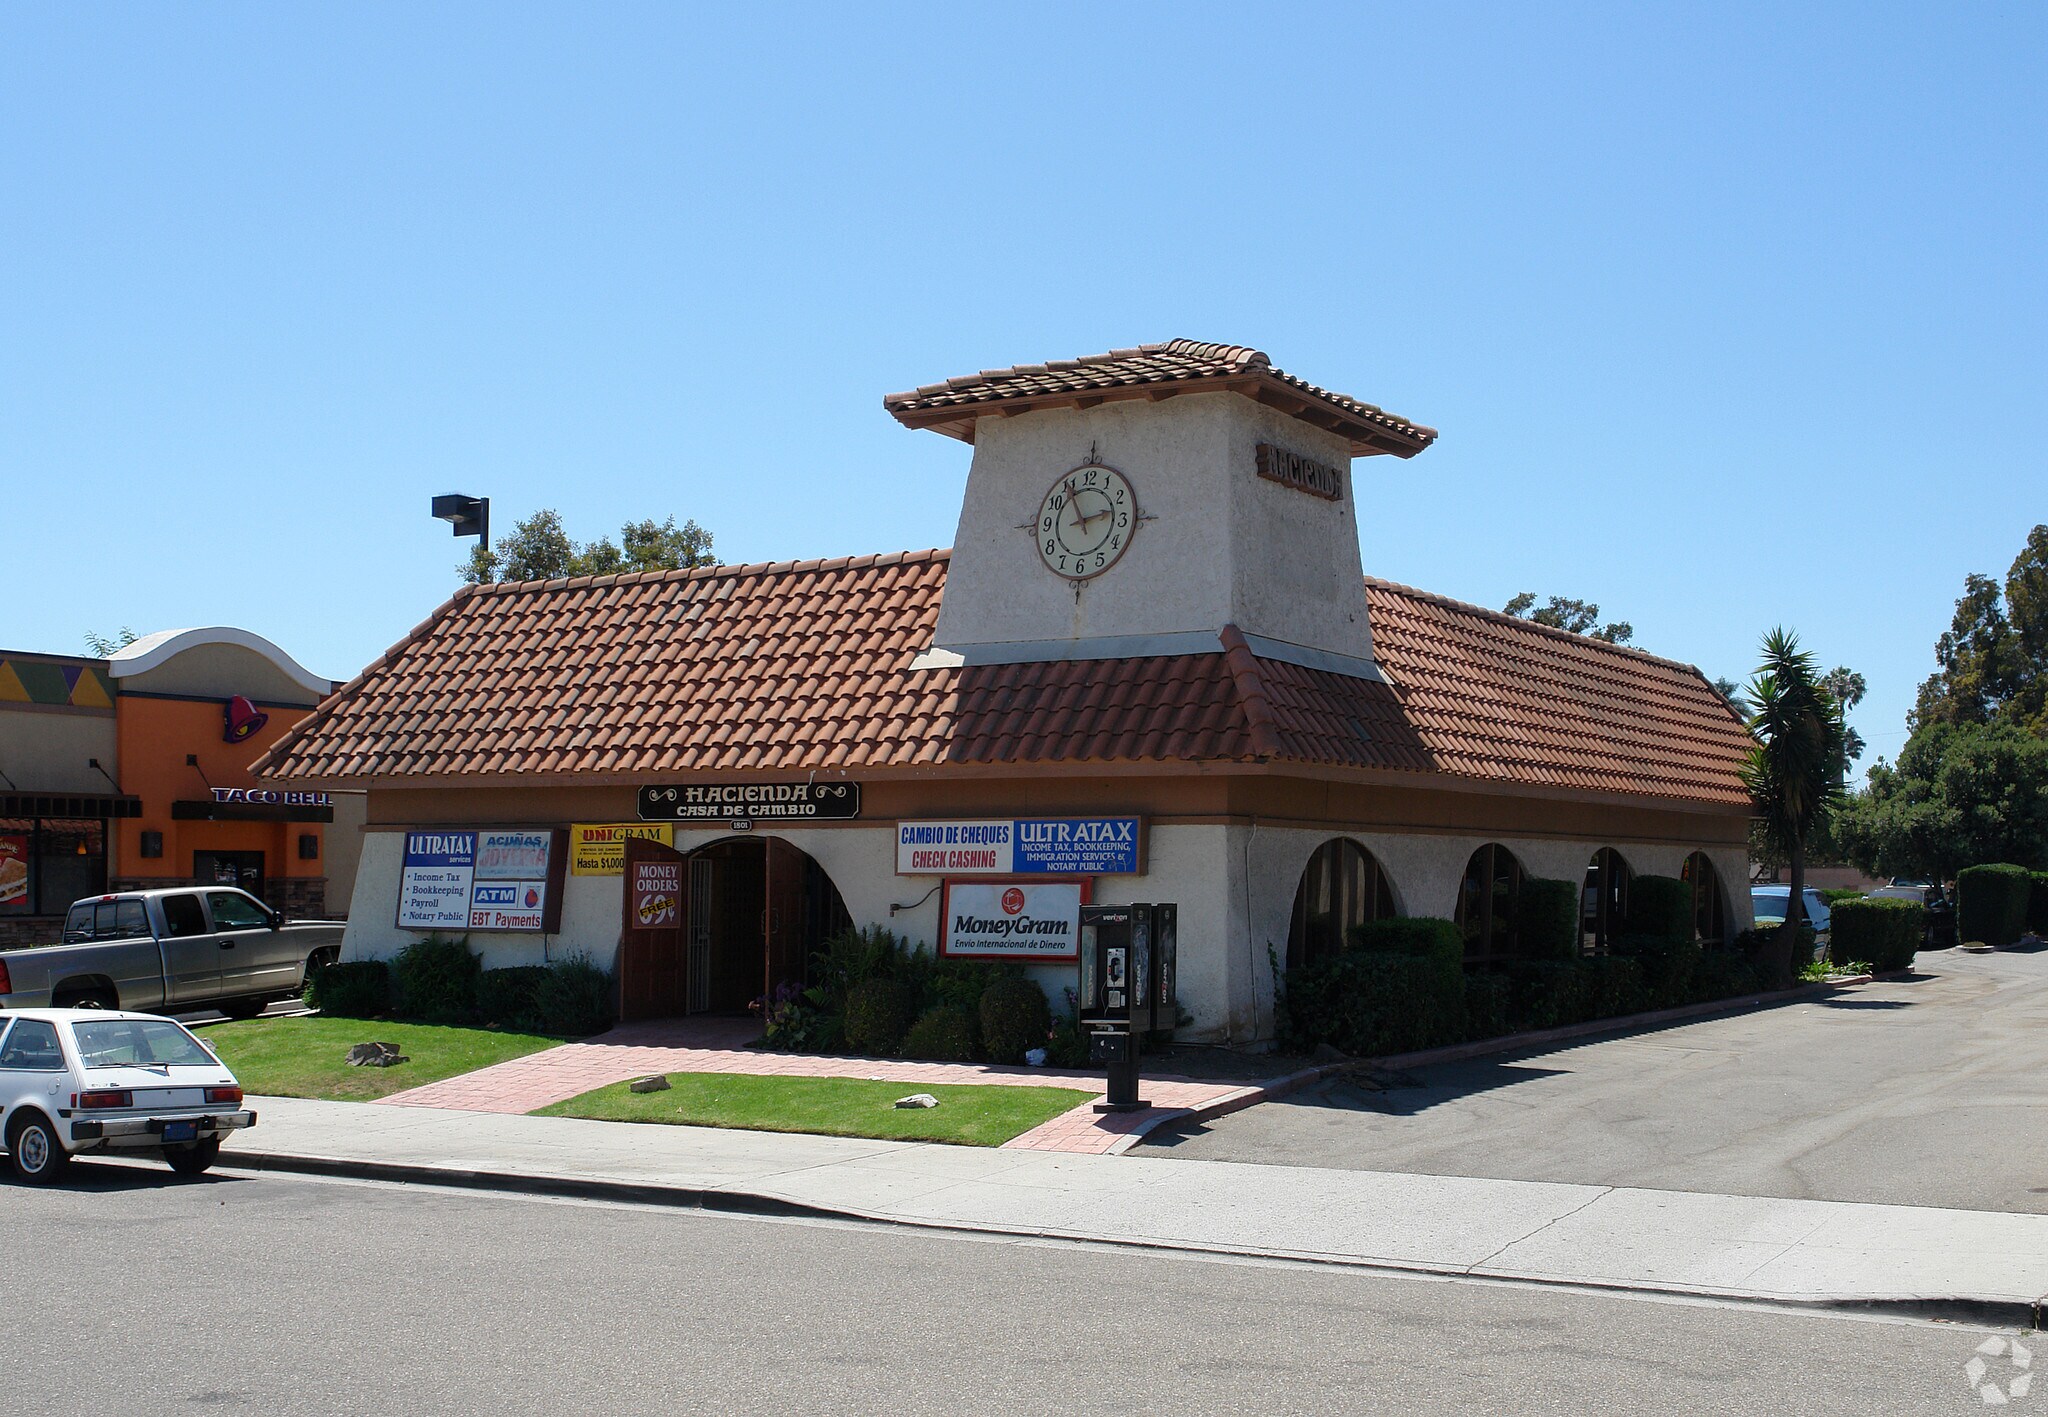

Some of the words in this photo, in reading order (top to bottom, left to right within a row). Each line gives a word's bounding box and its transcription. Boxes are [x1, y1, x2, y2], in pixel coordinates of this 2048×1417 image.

[1062, 477, 1077, 493] 11
[1082, 471, 1097, 486] 12
[1103, 475, 1111, 489] 1
[1048, 495, 1062, 510] 10
[1116, 490, 1124, 504] 2
[1043, 517, 1052, 532] 9
[1117, 512, 1127, 527] 3
[1045, 539, 1055, 555] 8
[1111, 534, 1120, 549] 4
[1059, 555, 1067, 570] 7
[1075, 559, 1084, 573] 6
[1095, 552, 1105, 567] 5
[210, 787, 280, 804] TACO
[284, 792, 334, 806] BELL
[686, 785, 808, 803] HACIENDA
[676, 805, 719, 816] CASA
[722, 805, 744, 816] DE
[748, 804, 816, 815] CAMBIO
[583, 828, 660, 841] UNIGRAM
[901, 827, 943, 844] CAMBIO
[945, 827, 959, 844] DE
[961, 825, 1009, 845] CHEQUES
[1020, 822, 1133, 842] ULTRATAX
[409, 835, 473, 855] ULTRATAX
[1021, 844, 1052, 852] INCOME
[1054, 843, 1072, 852] TAX,
[1074, 842, 1131, 852] BOOKKEEPING,
[577, 858, 599, 869] Hasta
[912, 851, 947, 868] CHECK
[949, 850, 996, 868] CASHING
[1026, 853, 1080, 861] IMMIGRATION
[1082, 852, 1116, 860] SERVICES
[639, 866, 677, 878] MONEY
[1047, 863, 1077, 871] NOTARY
[1079, 862, 1104, 871] PUBLIC
[414, 873, 444, 882] Income
[446, 873, 460, 882] Tax
[412, 886, 464, 897] Bookkeeping
[637, 880, 678, 891] ORDERS
[476, 889, 514, 901] ATM
[410, 899, 439, 909] Payroll
[640, 899, 674, 917] FREE
[408, 911, 436, 922] Notary
[438, 911, 464, 921] Public
[471, 911, 491, 926] EBT
[495, 911, 541, 929] Payments
[1102, 914, 1128, 922] verizon
[954, 915, 1068, 938] MoneyGram
[955, 940, 976, 948] Envio
[976, 939, 1027, 949] Internacional
[1028, 939, 1038, 949] de
[1039, 940, 1066, 949] Dinero
